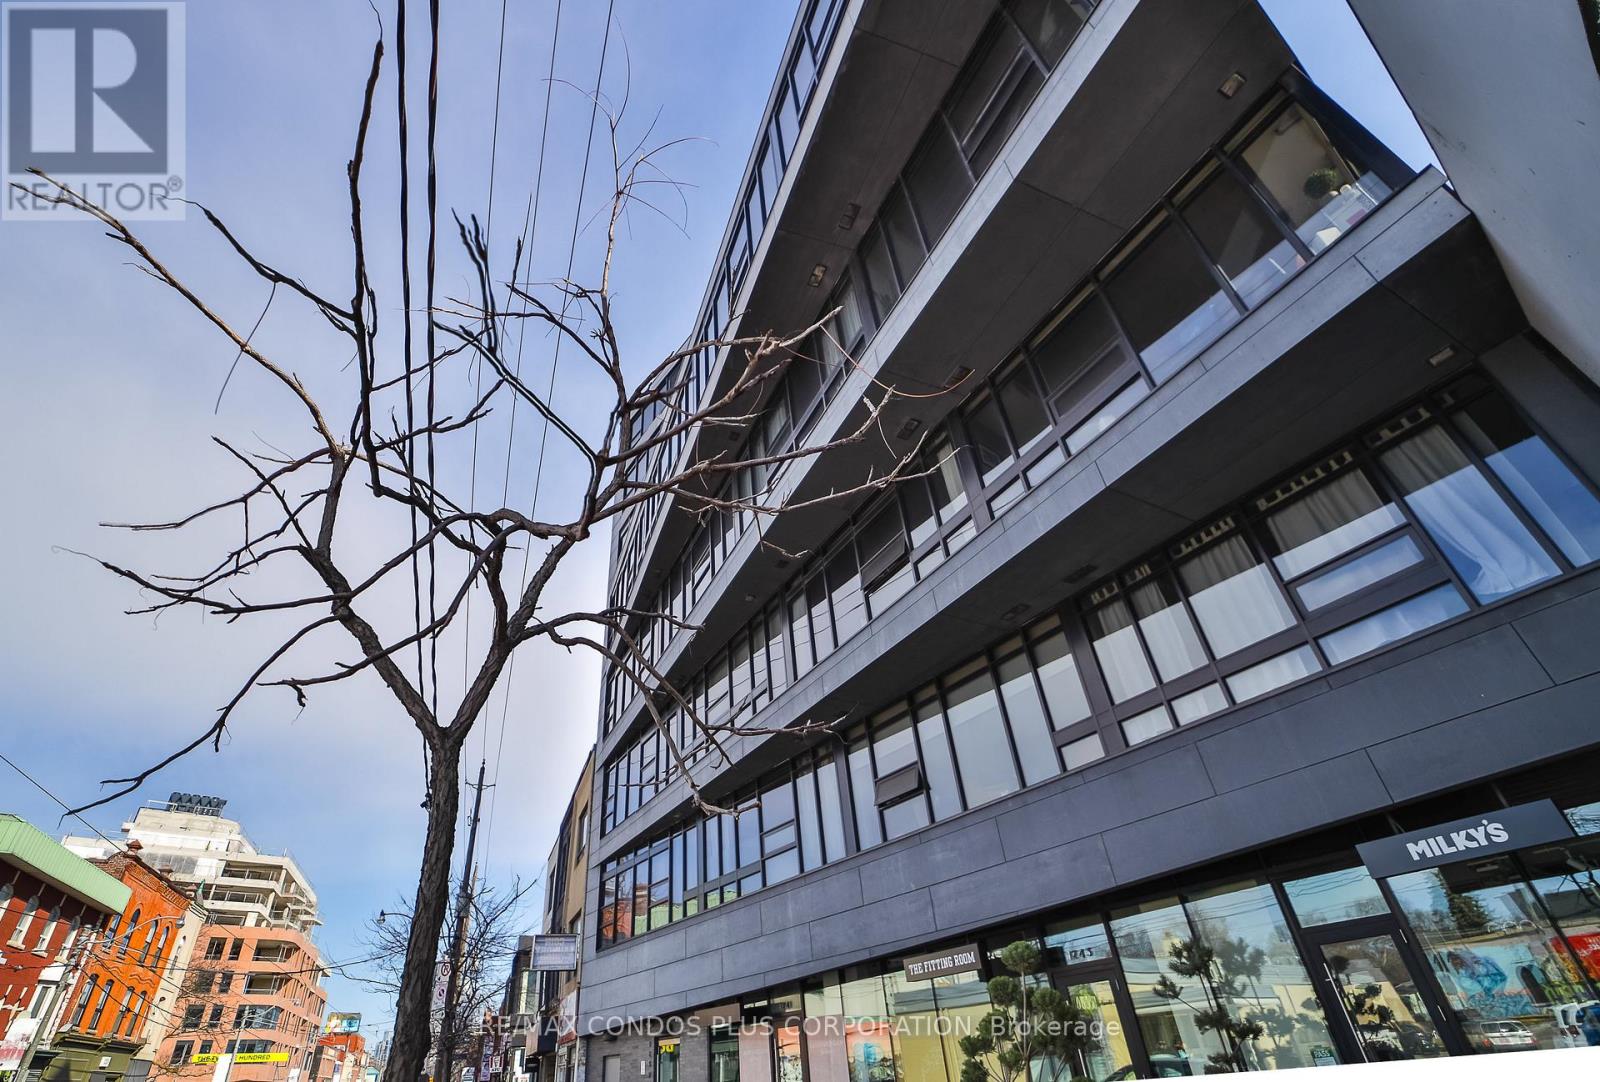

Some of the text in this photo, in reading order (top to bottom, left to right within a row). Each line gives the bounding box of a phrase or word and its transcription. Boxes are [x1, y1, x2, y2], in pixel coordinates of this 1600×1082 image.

[1406, 819, 1509, 861] MILKY'S
[908, 962, 924, 975] THE
[924, 956, 953, 972] FITTING
[954, 951, 976, 967] ROOM
